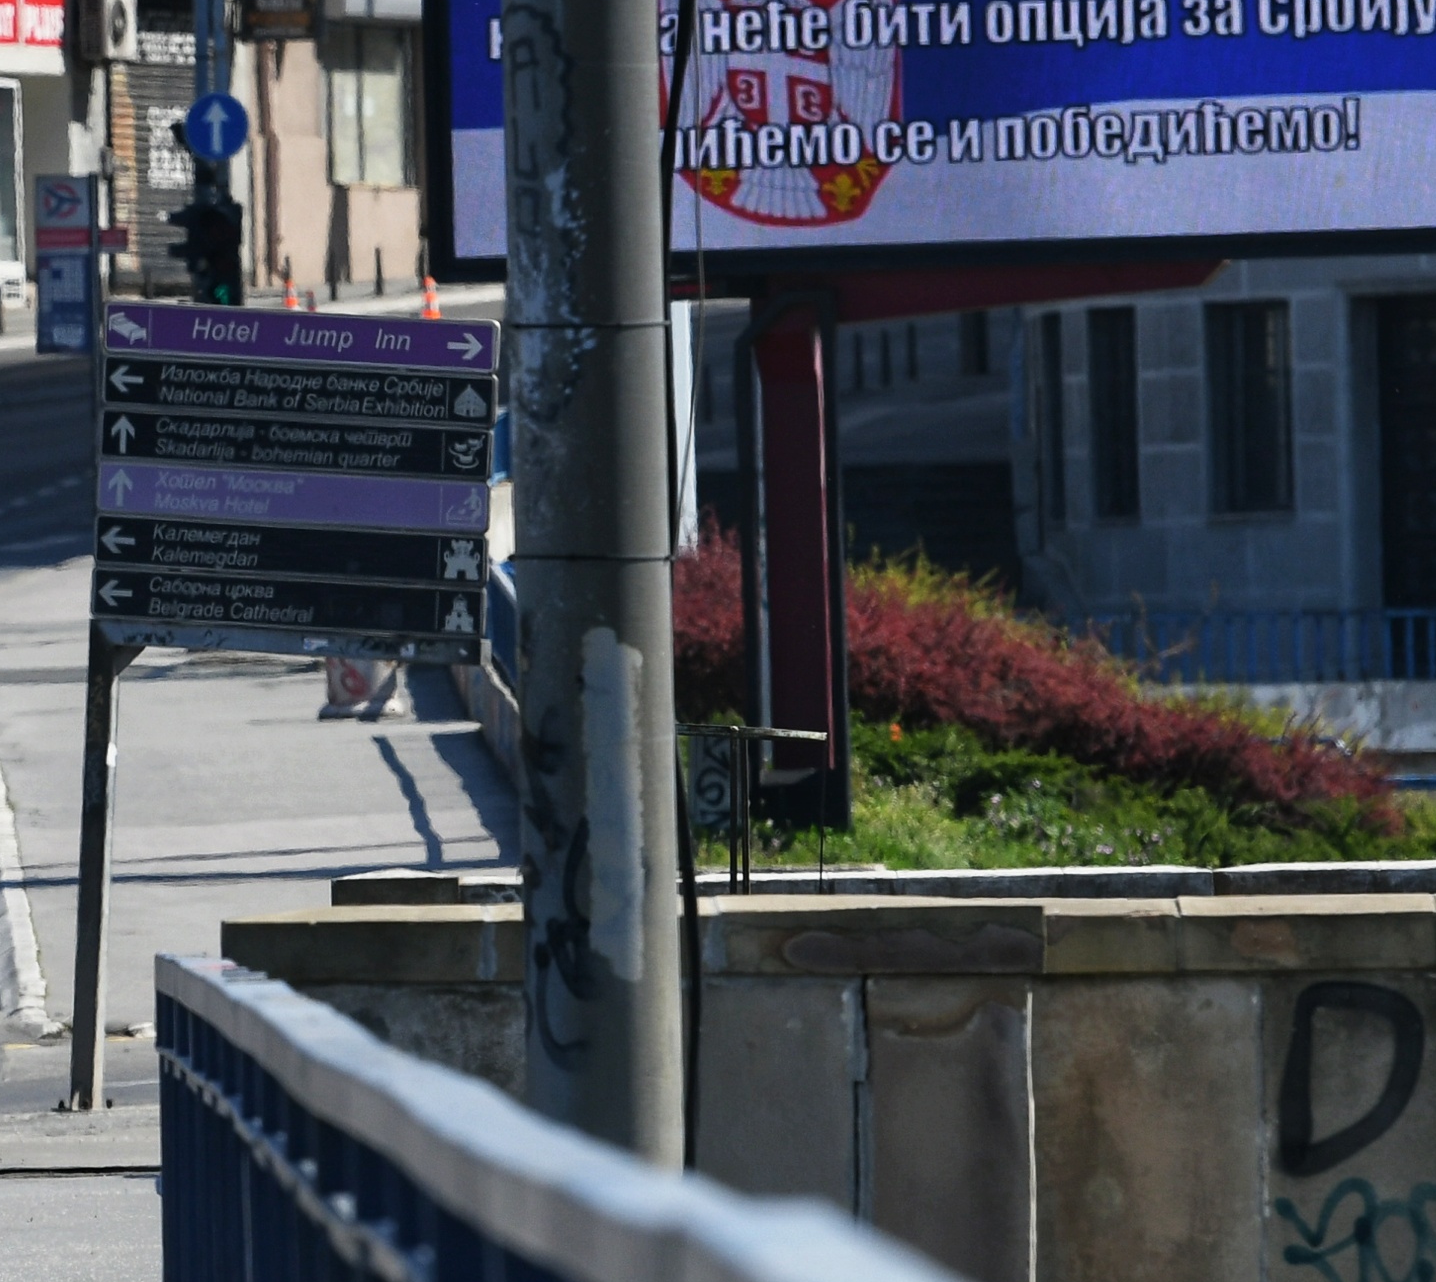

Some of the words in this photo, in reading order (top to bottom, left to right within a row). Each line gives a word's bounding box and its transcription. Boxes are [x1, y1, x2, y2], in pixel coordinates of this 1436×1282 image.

[876, 122, 935, 165] се
[948, 118, 983, 163] и
[994, 96, 1362, 164] победићемо!
[192, 317, 259, 343] Hotel
[285, 323, 354, 352] Jump
[375, 328, 412, 351] Inn
[160, 366, 241, 386] Изложба
[244, 369, 323, 391] Народне
[326, 373, 380, 393] банке
[159, 386, 229, 405] National
[234, 390, 278, 408] Bank
[283, 392, 302, 409] of
[305, 395, 360, 412] Serbia
[362, 397, 445, 419] Exhibition
[155, 439, 235, 461] Skadarlija
[252, 445, 336, 466] bohemian
[338, 452, 402, 469] quarter
[154, 493, 219, 512] Moskva
[224, 495, 270, 514] Hotel
[151, 545, 259, 570] Kalemegdan
[149, 576, 221, 598] Саборна
[225, 583, 275, 601] црква
[148, 597, 225, 620] Belgrade
[230, 603, 315, 623] Cathedral
